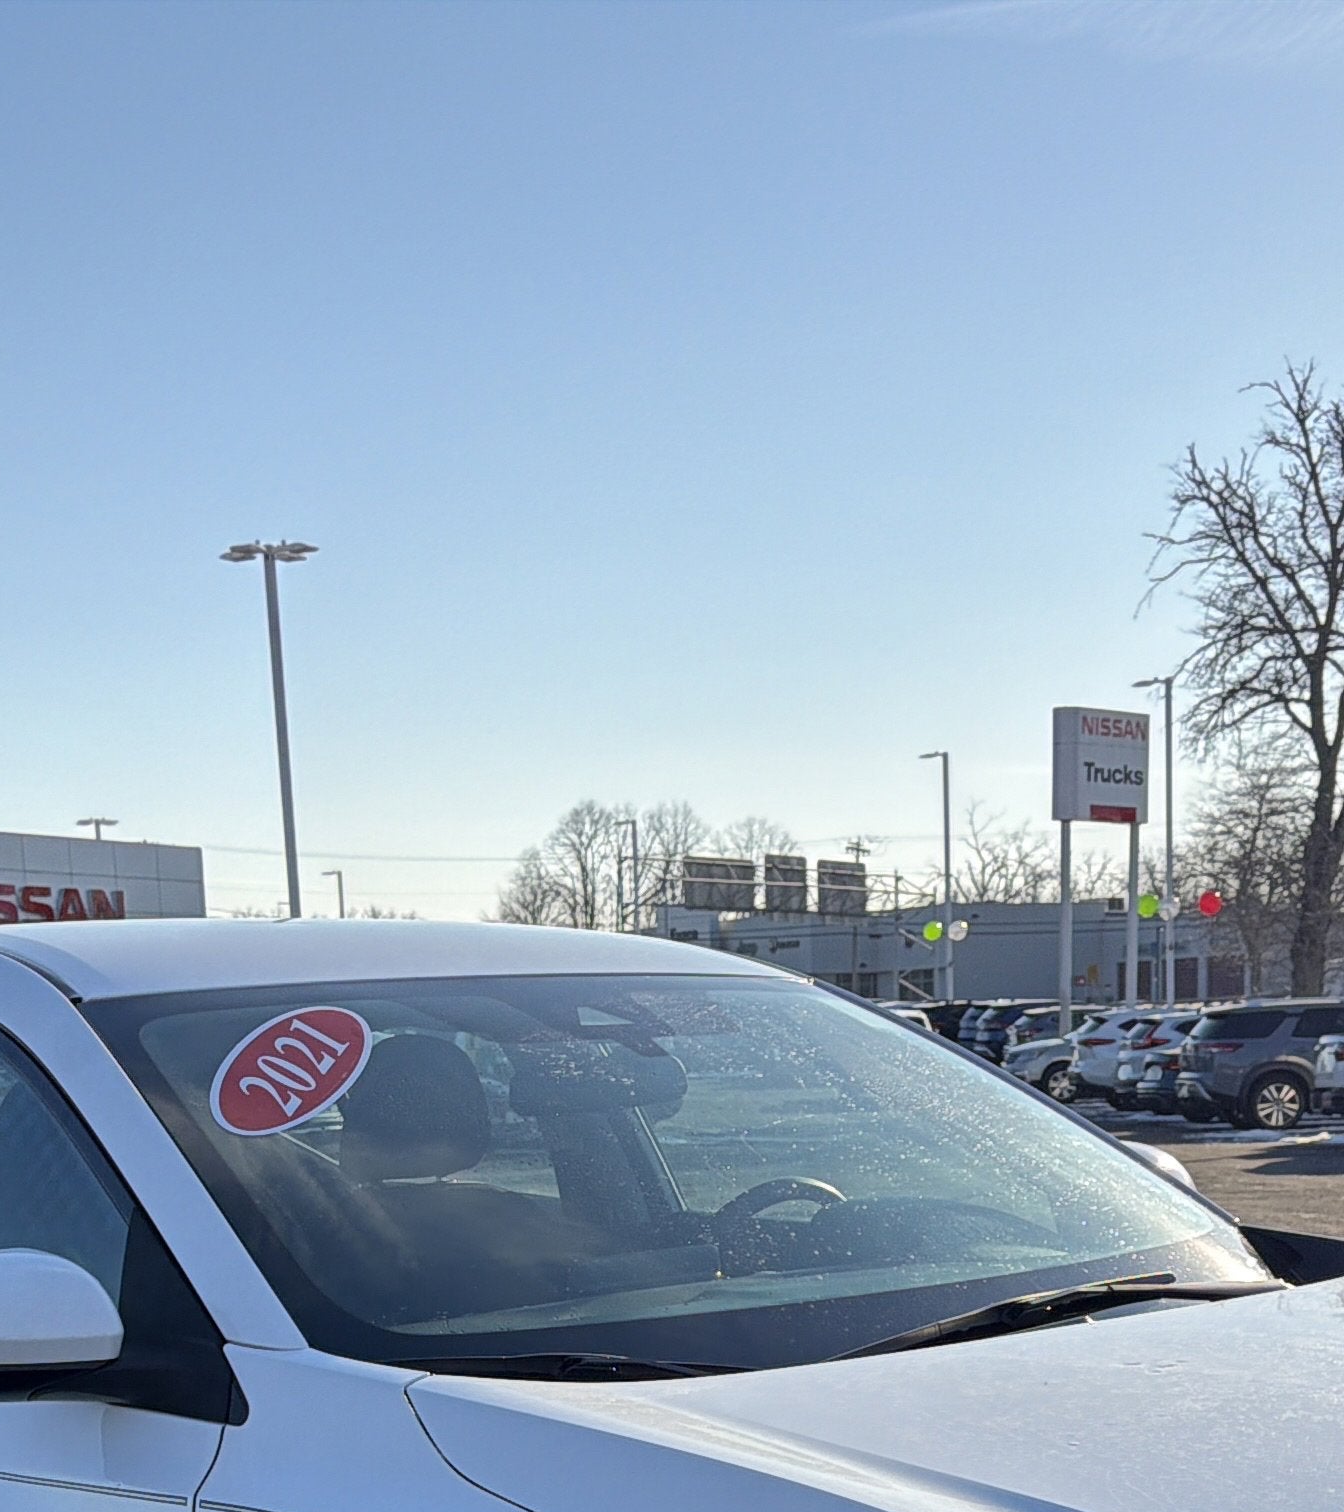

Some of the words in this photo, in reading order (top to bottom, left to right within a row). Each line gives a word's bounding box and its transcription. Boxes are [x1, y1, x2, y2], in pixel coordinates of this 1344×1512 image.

[1081, 714, 1146, 741] NISSAN
[1084, 760, 1145, 785] Trucks
[239, 1018, 349, 1117] 2021
